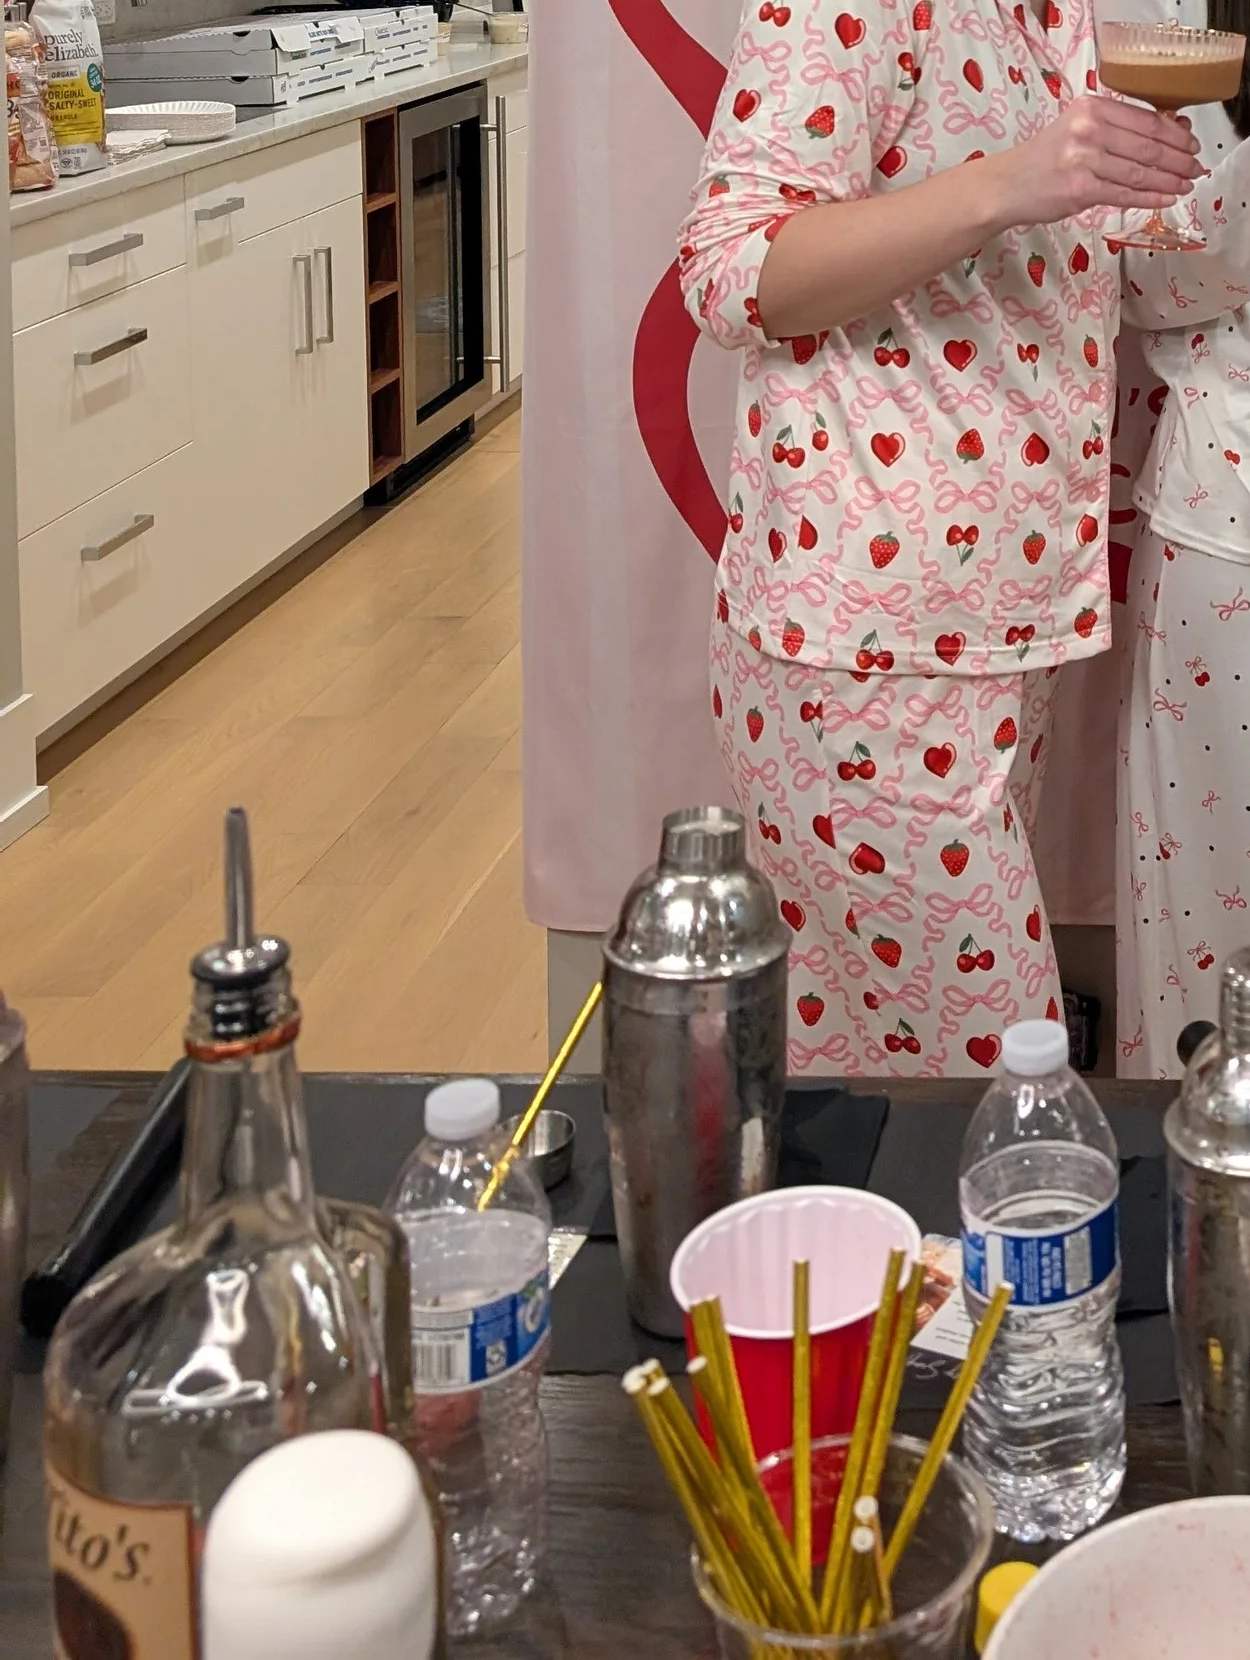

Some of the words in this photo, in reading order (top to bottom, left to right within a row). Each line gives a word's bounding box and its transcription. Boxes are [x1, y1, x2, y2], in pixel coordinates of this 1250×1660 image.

[44, 28, 83, 46] purely
[51, 69, 78, 79] ORGANIC
[47, 87, 85, 100] ORIGINAL
[49, 97, 97, 111] SALTY-SWEET
